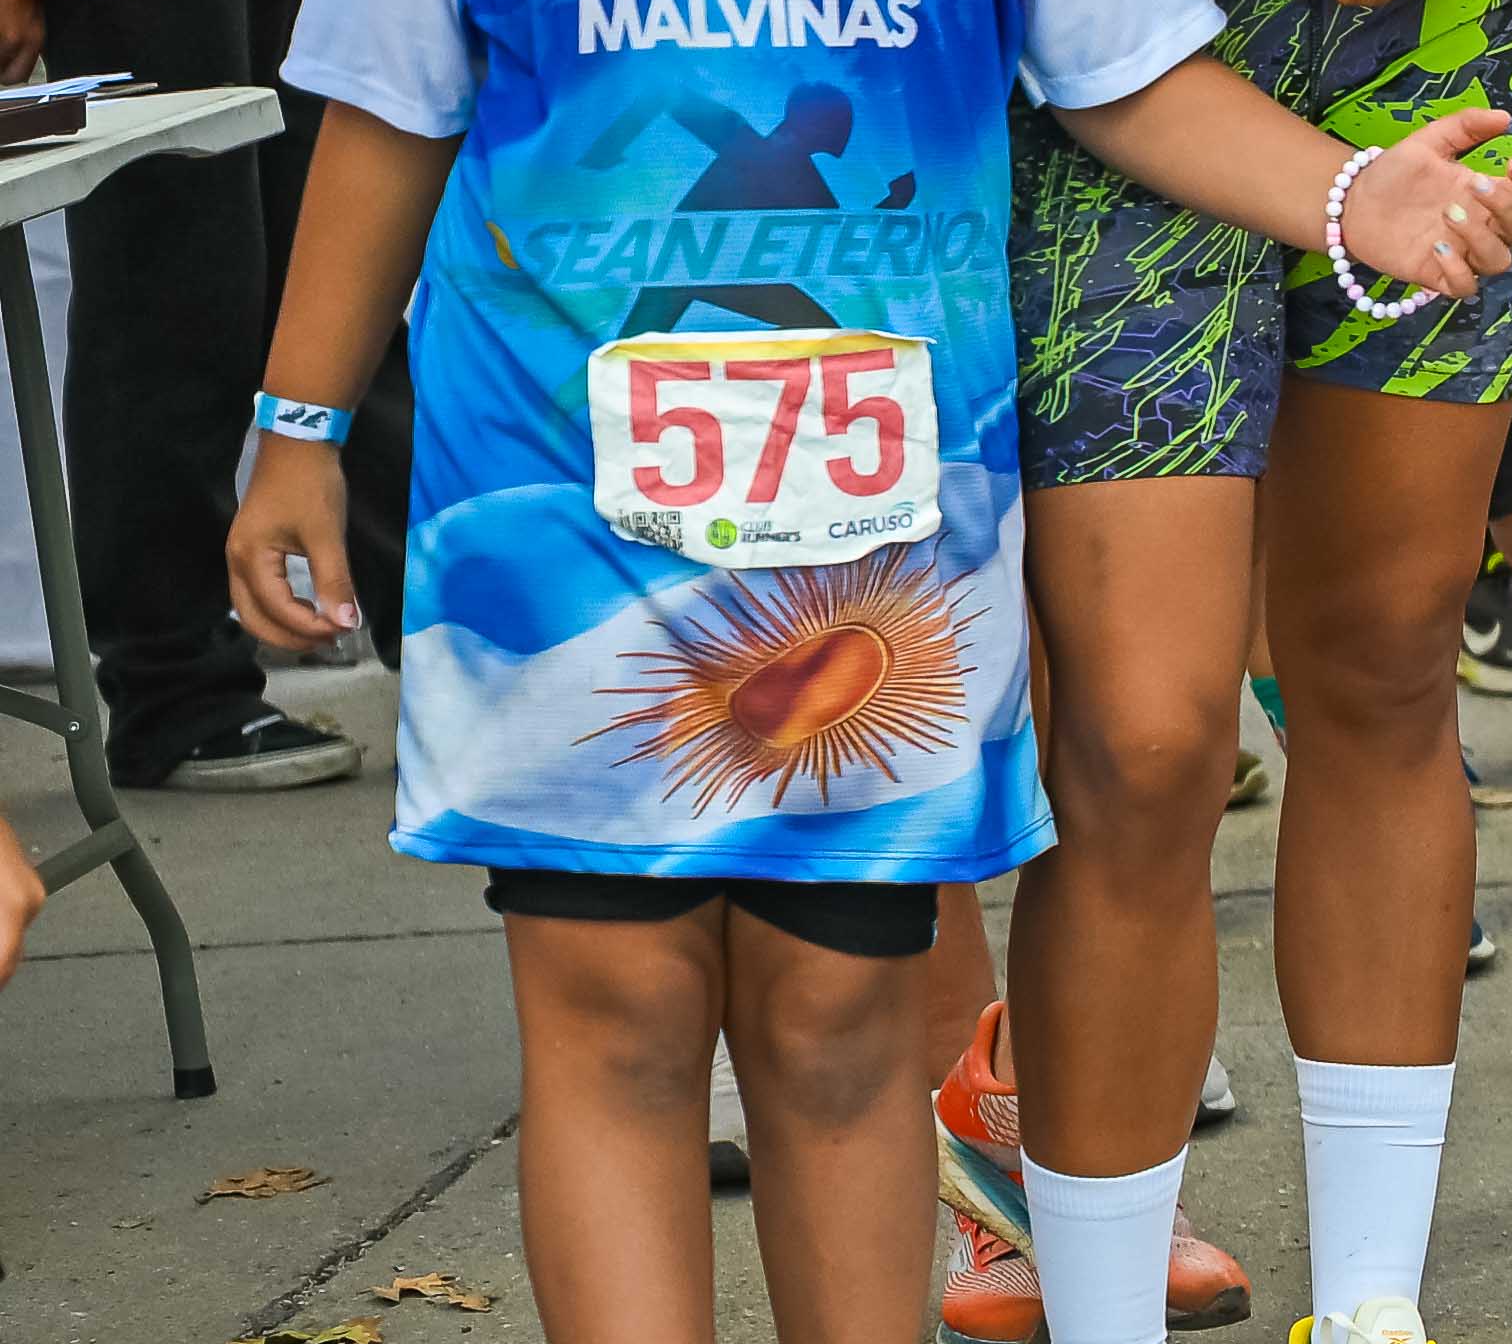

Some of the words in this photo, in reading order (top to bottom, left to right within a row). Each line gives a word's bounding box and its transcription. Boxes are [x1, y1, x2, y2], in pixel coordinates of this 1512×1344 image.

[524, 215, 729, 285] SEAN
[628, 347, 905, 506] 575
[828, 513, 913, 540] CARUSO
